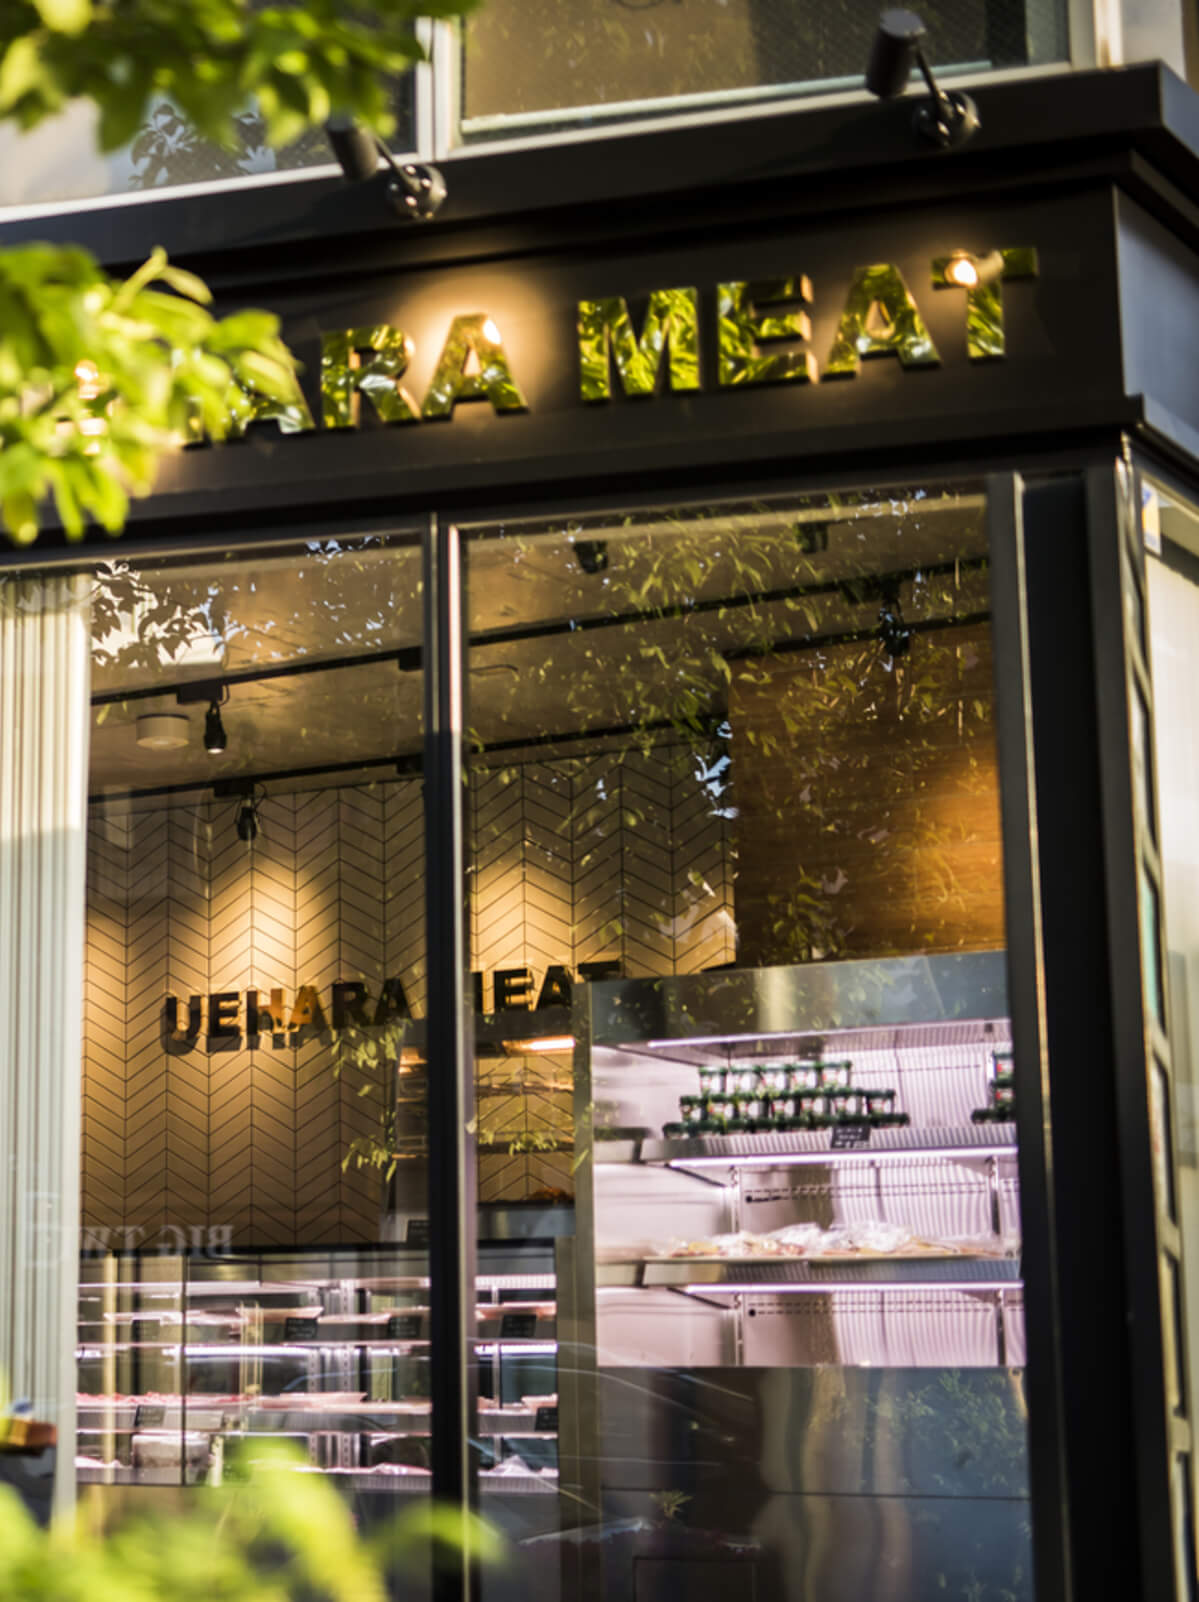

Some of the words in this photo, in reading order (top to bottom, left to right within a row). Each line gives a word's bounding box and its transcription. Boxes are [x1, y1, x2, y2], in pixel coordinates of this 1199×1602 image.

[185, 313, 530, 446] ARA
[578, 247, 1038, 401] MEAT
[162, 977, 414, 1040] UEHARA
